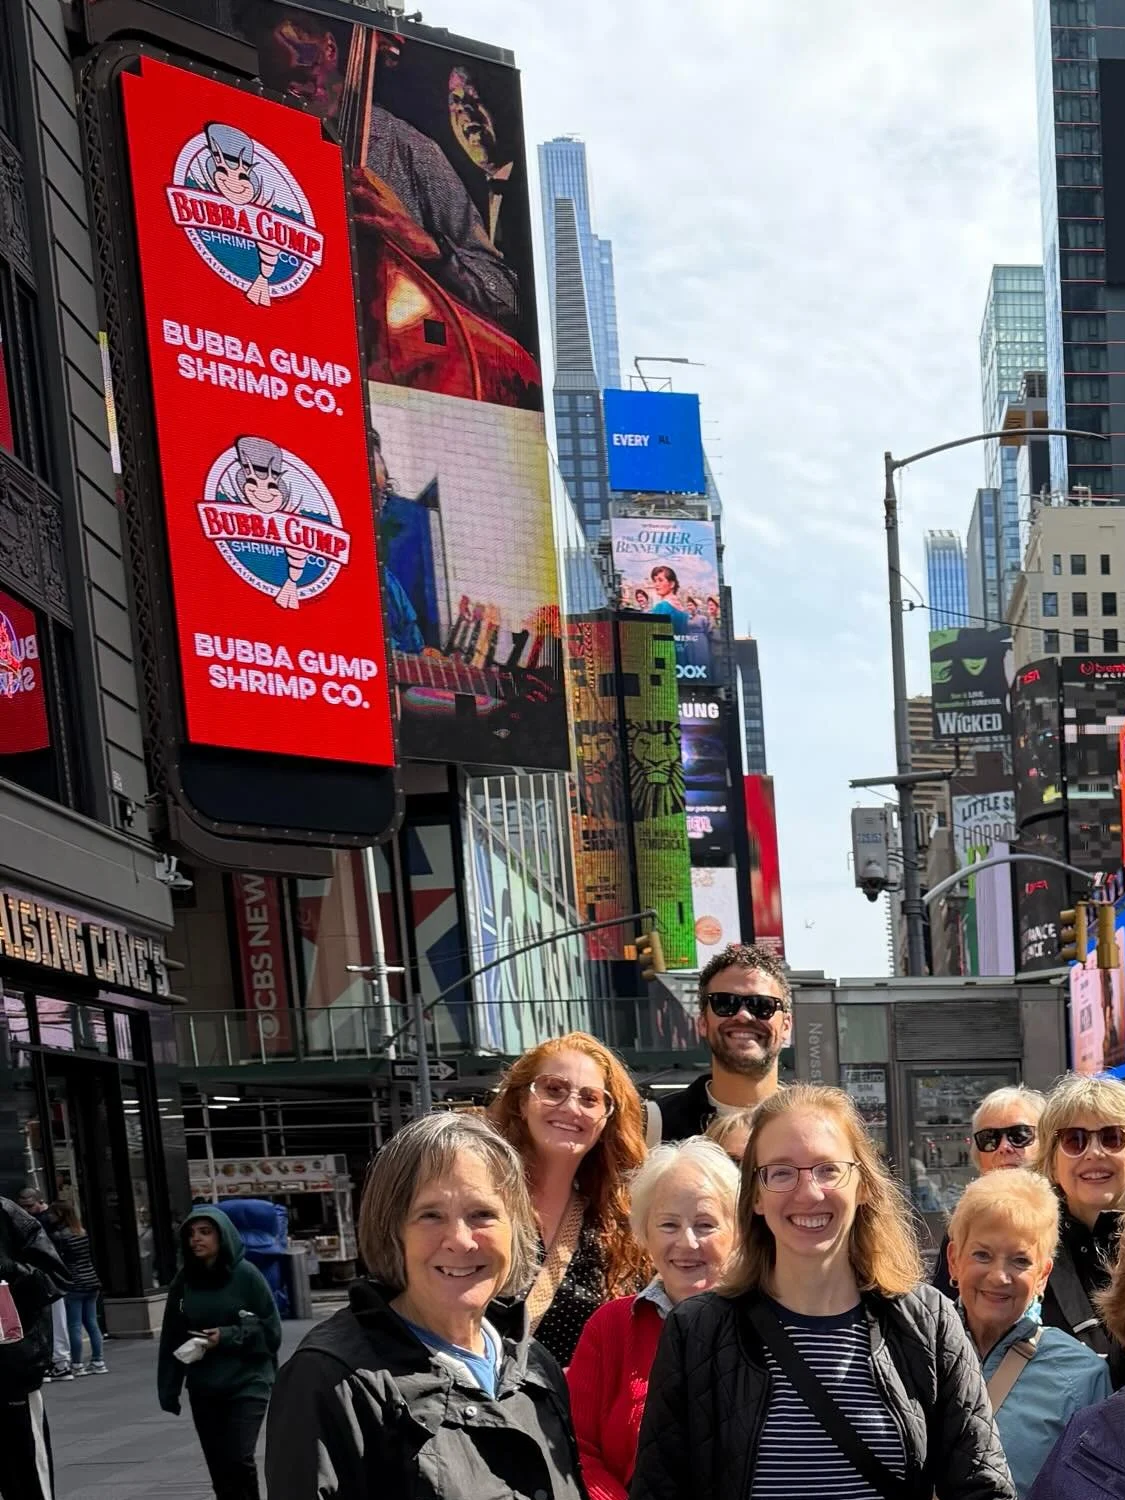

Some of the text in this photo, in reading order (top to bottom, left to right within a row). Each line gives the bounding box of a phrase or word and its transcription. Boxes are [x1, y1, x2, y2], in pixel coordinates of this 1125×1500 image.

[172, 191, 321, 259] BUBBA GUMP
[201, 231, 256, 250] SHRIMP
[163, 319, 351, 387] BUBBA GUMP
[177, 353, 344, 416] SHRIMP CO.
[613, 433, 650, 446] EVERY
[203, 507, 347, 557] BUBBA GUMP
[231, 541, 285, 557] SHRIMP
[616, 541, 703, 556] BENNET SISTER
[638, 531, 691, 544] OTHER
[194, 632, 378, 681] BUBBA GUMP
[208, 664, 370, 709] SHRIMP CO.
[961, 795, 1001, 822] LITTLE
[89, 923, 171, 996] CANE'S
[251, 952, 277, 1014] CBS
